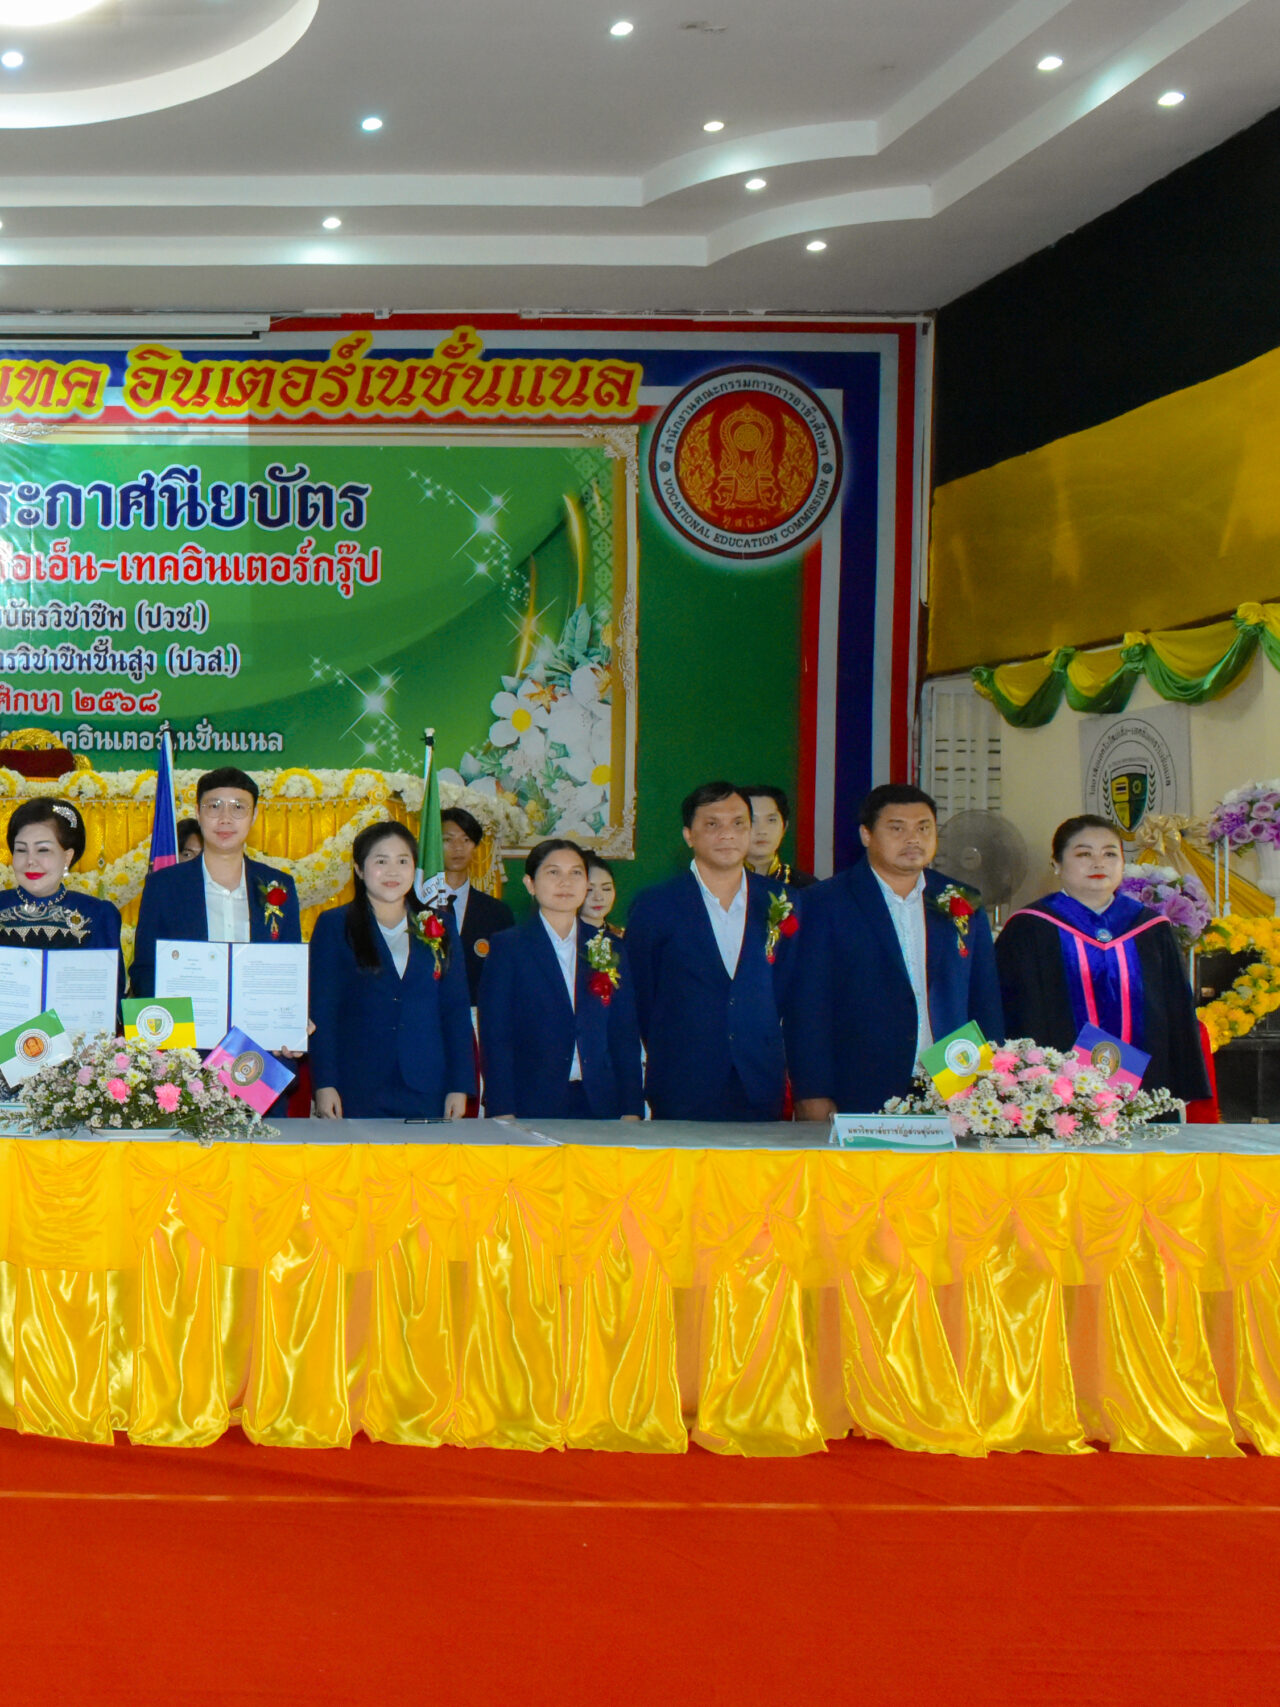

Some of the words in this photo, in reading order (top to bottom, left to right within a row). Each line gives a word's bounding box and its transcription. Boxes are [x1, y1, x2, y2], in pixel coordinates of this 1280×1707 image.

[129, 333, 637, 408] อินเตอร์เนชั่นแนล
[663, 478, 710, 538] VOCATIONAL
[713, 532, 778, 548] EDUCATION
[781, 479, 830, 538] COMMISSION
[137, 602, 208, 631] (ปวช.)
[168, 645, 239, 675] (ปวส.)
[75, 691, 158, 712] ๒๕๖๘
